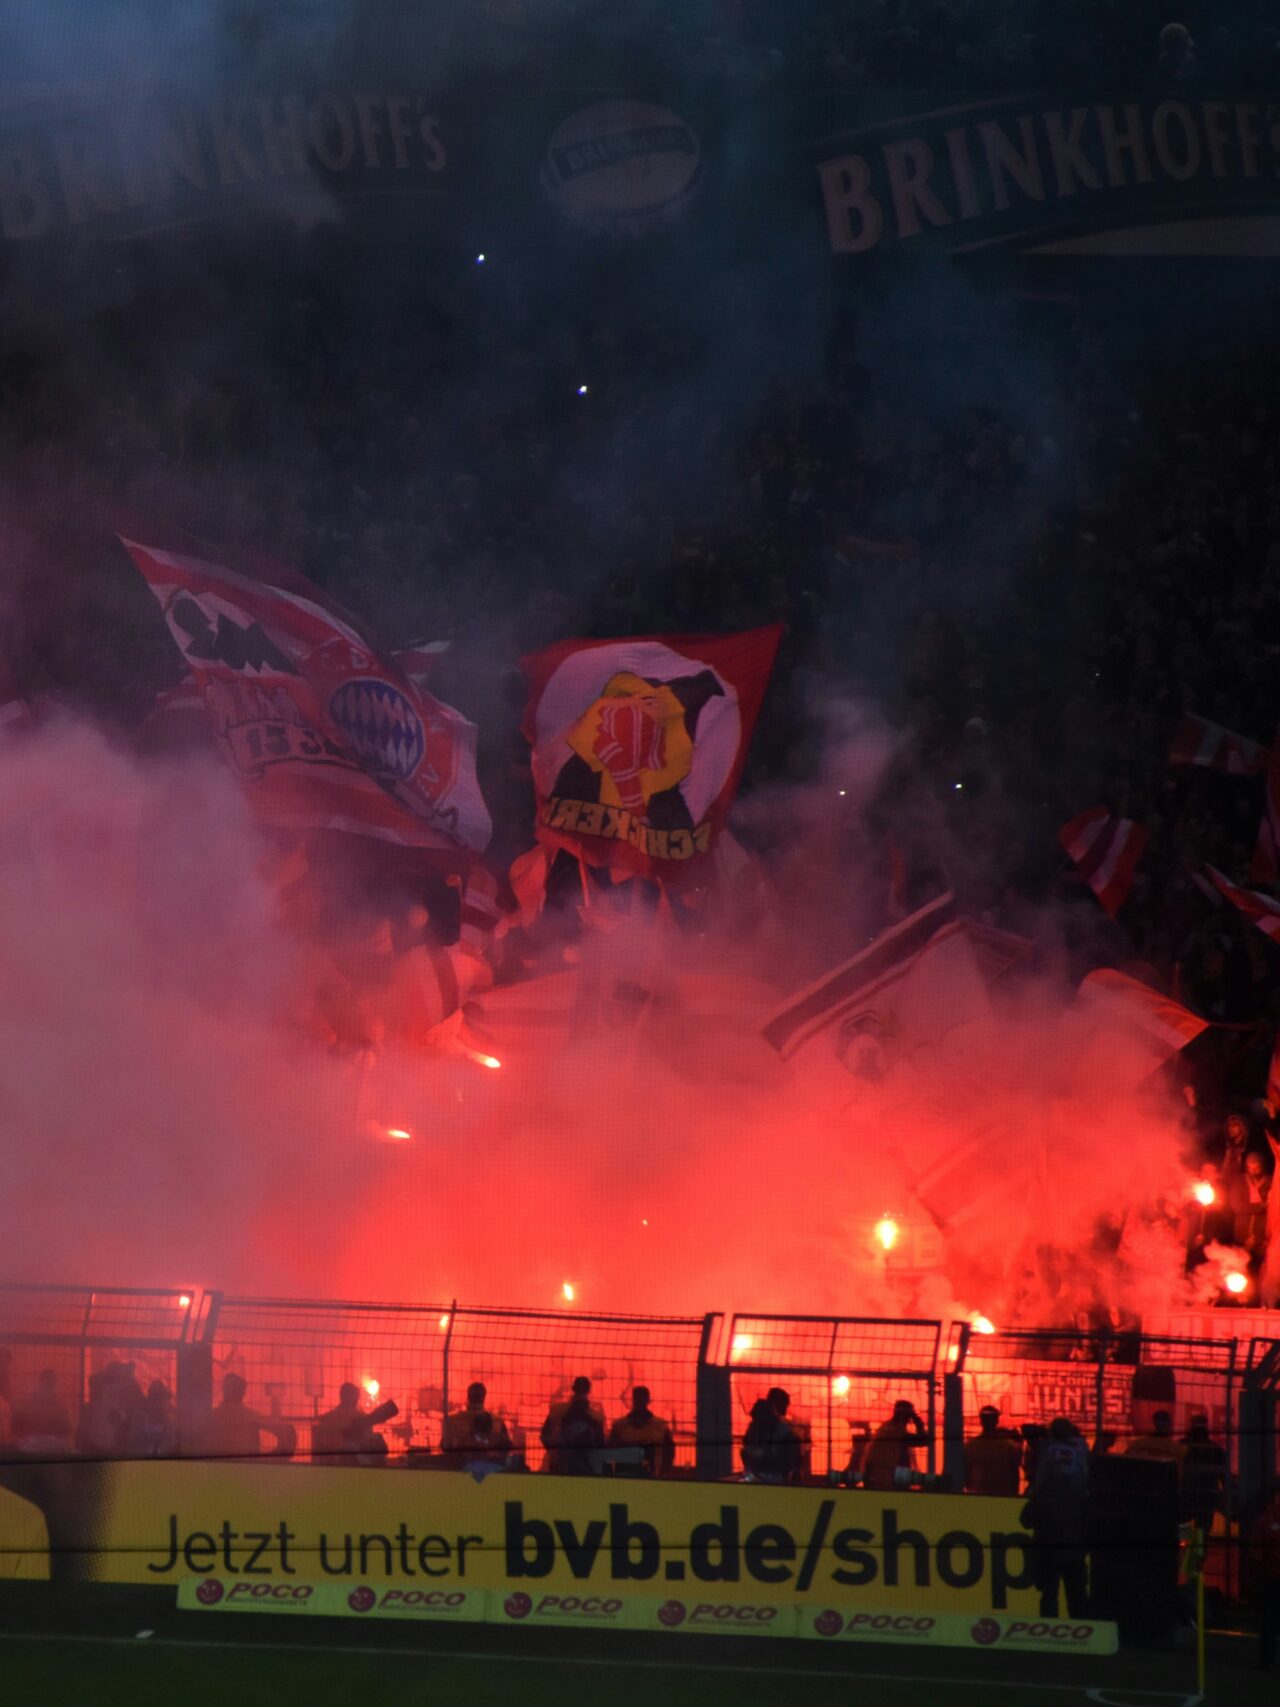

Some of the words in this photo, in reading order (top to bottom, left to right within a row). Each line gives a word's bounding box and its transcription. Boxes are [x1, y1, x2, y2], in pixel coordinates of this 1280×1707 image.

[148, 1515, 296, 1575] Jetzt
[320, 1523, 485, 1577] unter
[504, 1500, 1039, 1609] bvb.de/shop
[228, 1582, 315, 1600] POCO
[377, 1590, 467, 1607] POCO
[534, 1596, 623, 1614] POCO
[687, 1604, 778, 1622] POCO
[846, 1613, 936, 1631] POCO
[1004, 1622, 1095, 1641] POCO
